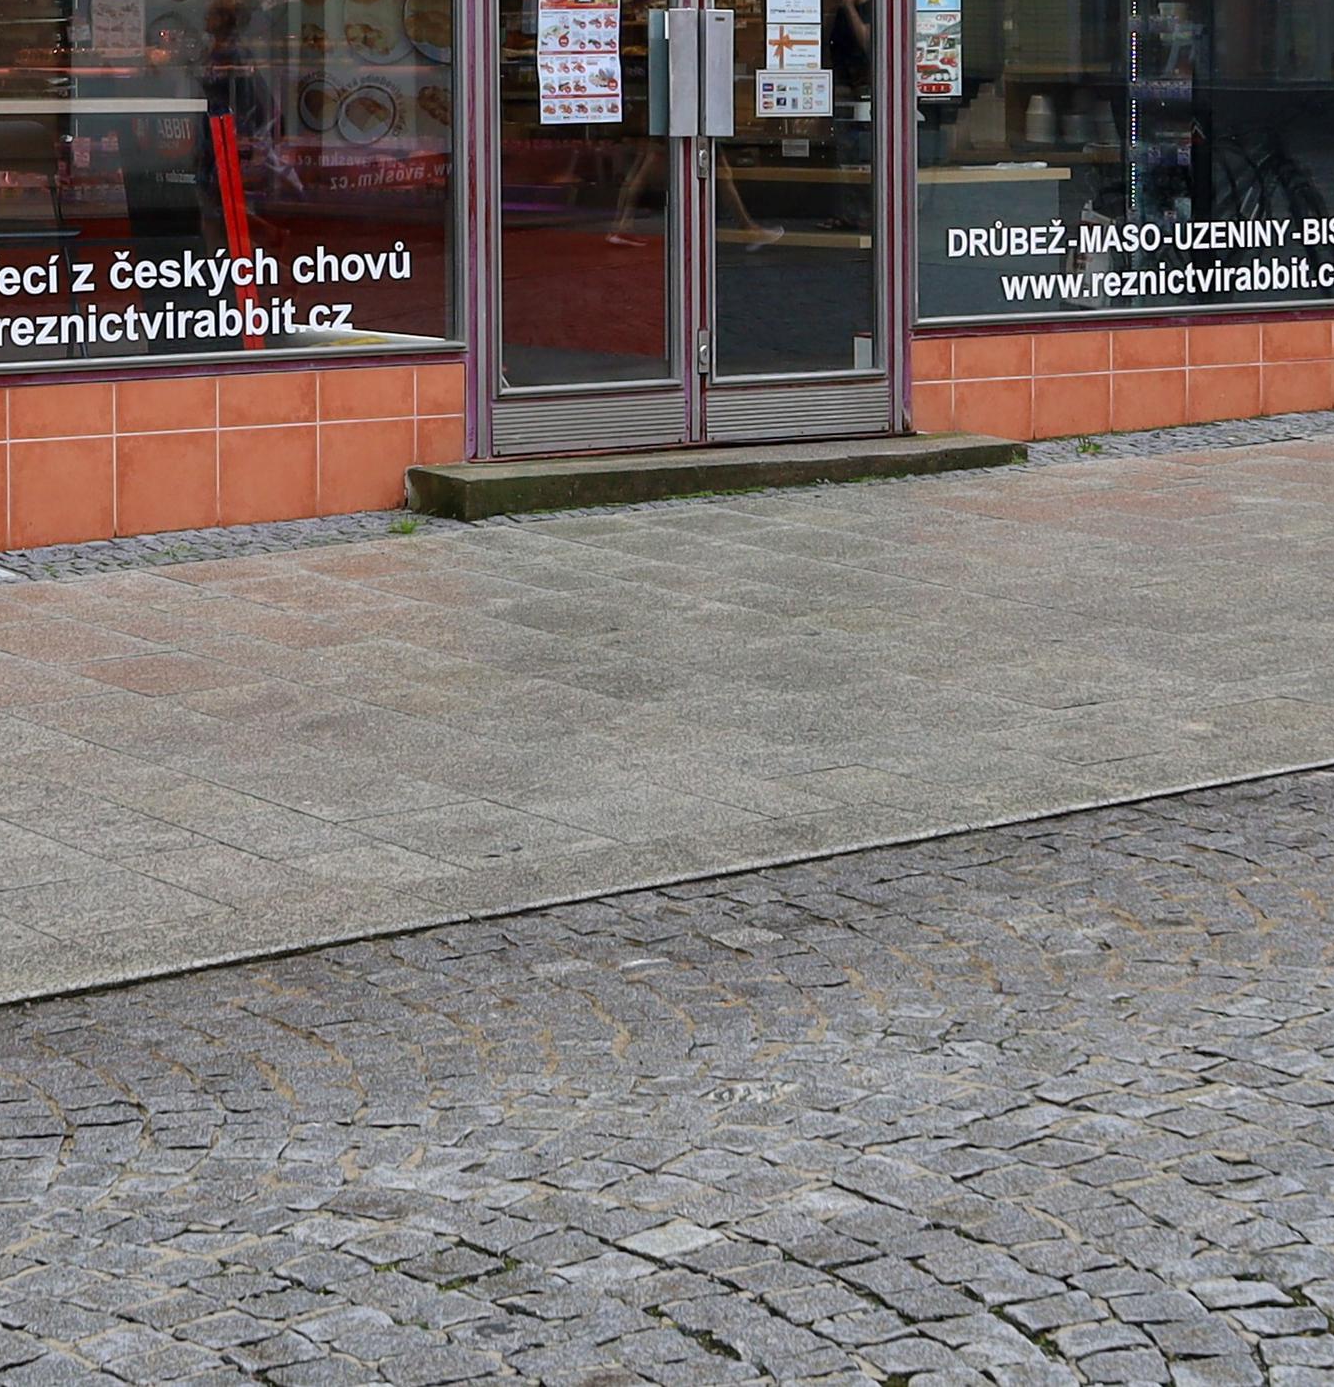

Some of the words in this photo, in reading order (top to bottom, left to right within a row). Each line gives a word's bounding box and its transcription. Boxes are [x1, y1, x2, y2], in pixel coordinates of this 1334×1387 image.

[71, 262, 95, 293] z
[109, 248, 279, 297] českých
[292, 241, 412, 283] chovů
